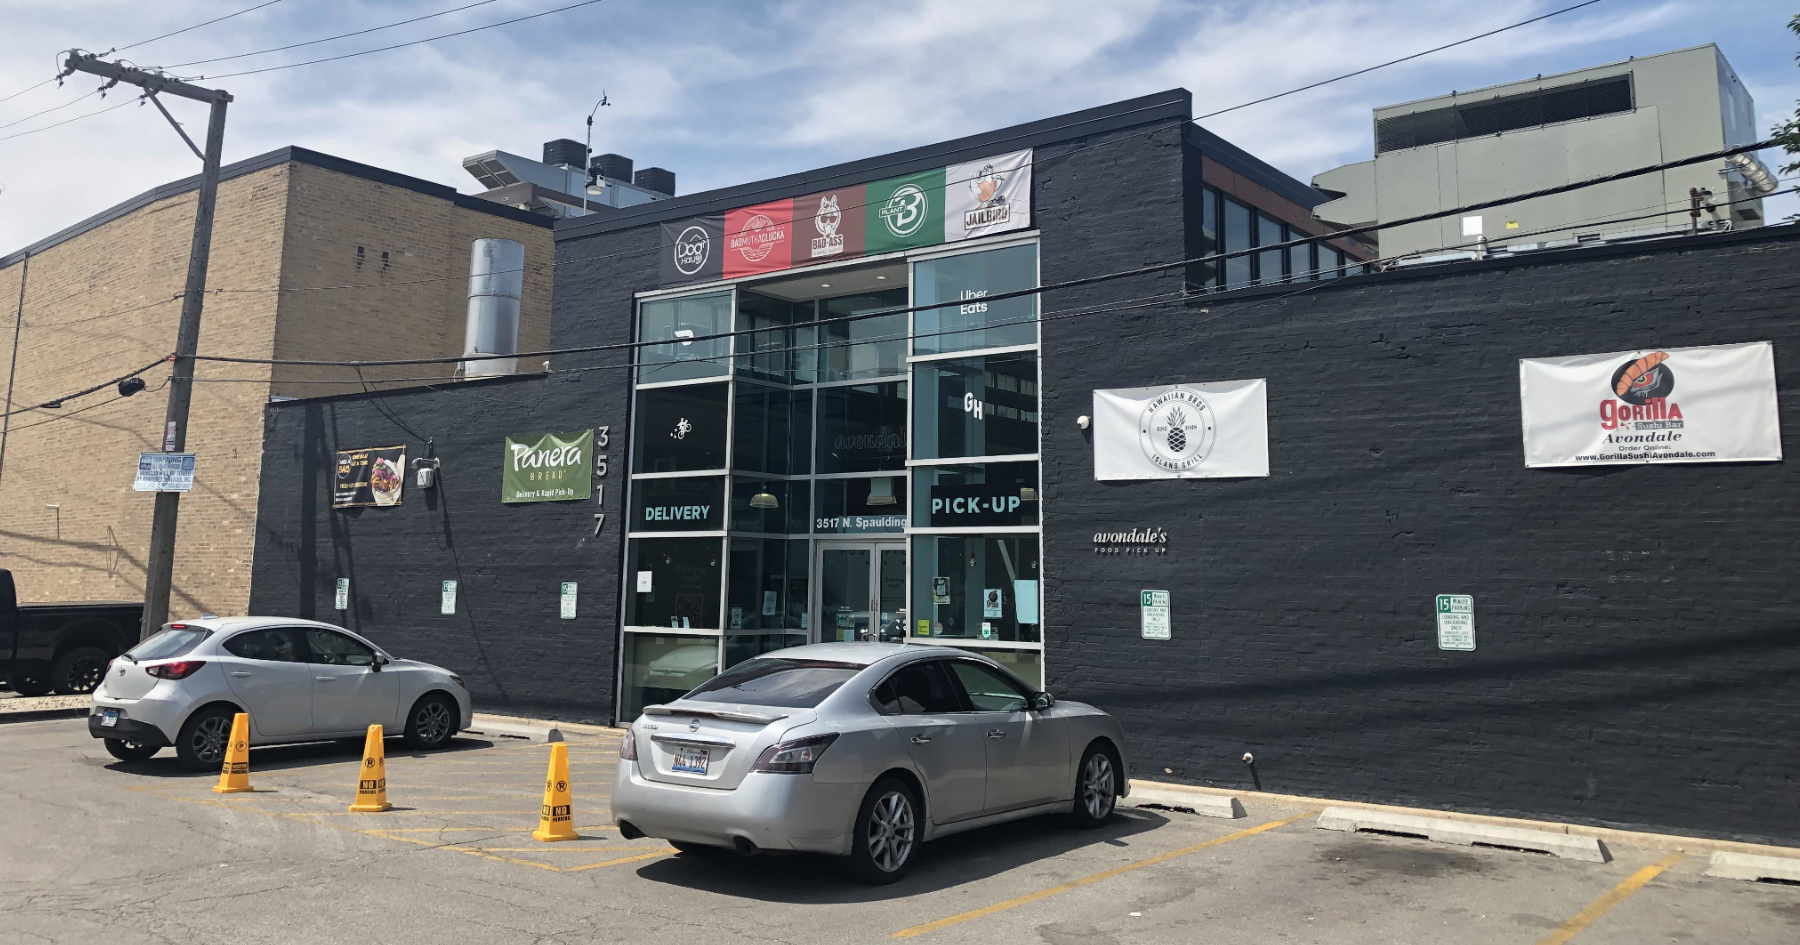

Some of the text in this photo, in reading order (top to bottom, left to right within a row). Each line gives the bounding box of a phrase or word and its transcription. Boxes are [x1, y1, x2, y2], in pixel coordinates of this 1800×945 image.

[881, 206, 904, 216] PLANT
[966, 207, 1008, 226] JAILBIRD
[961, 289, 988, 300] Uber
[960, 302, 988, 315] Eats
[964, 392, 983, 420] GH
[1148, 392, 1206, 413] HAWAIIAN BROS
[1665, 421, 1682, 429] Bar
[1602, 431, 1682, 444] Avondale
[511, 443, 581, 472] Panera
[1152, 453, 1203, 470] ISLAND GRILL
[1575, 450, 1716, 461] www.GorillaSushiAvondale.com
[932, 496, 1021, 514] PICK-UP
[645, 505, 710, 520] DELIVERY
[816, 516, 907, 530] 3517 N. Spaulding
[1093, 527, 1167, 543] avondale's
[1143, 593, 1152, 605] 15
[1439, 598, 1450, 611] 15
[362, 780, 374, 789] NO
[555, 805, 567, 815] NO
